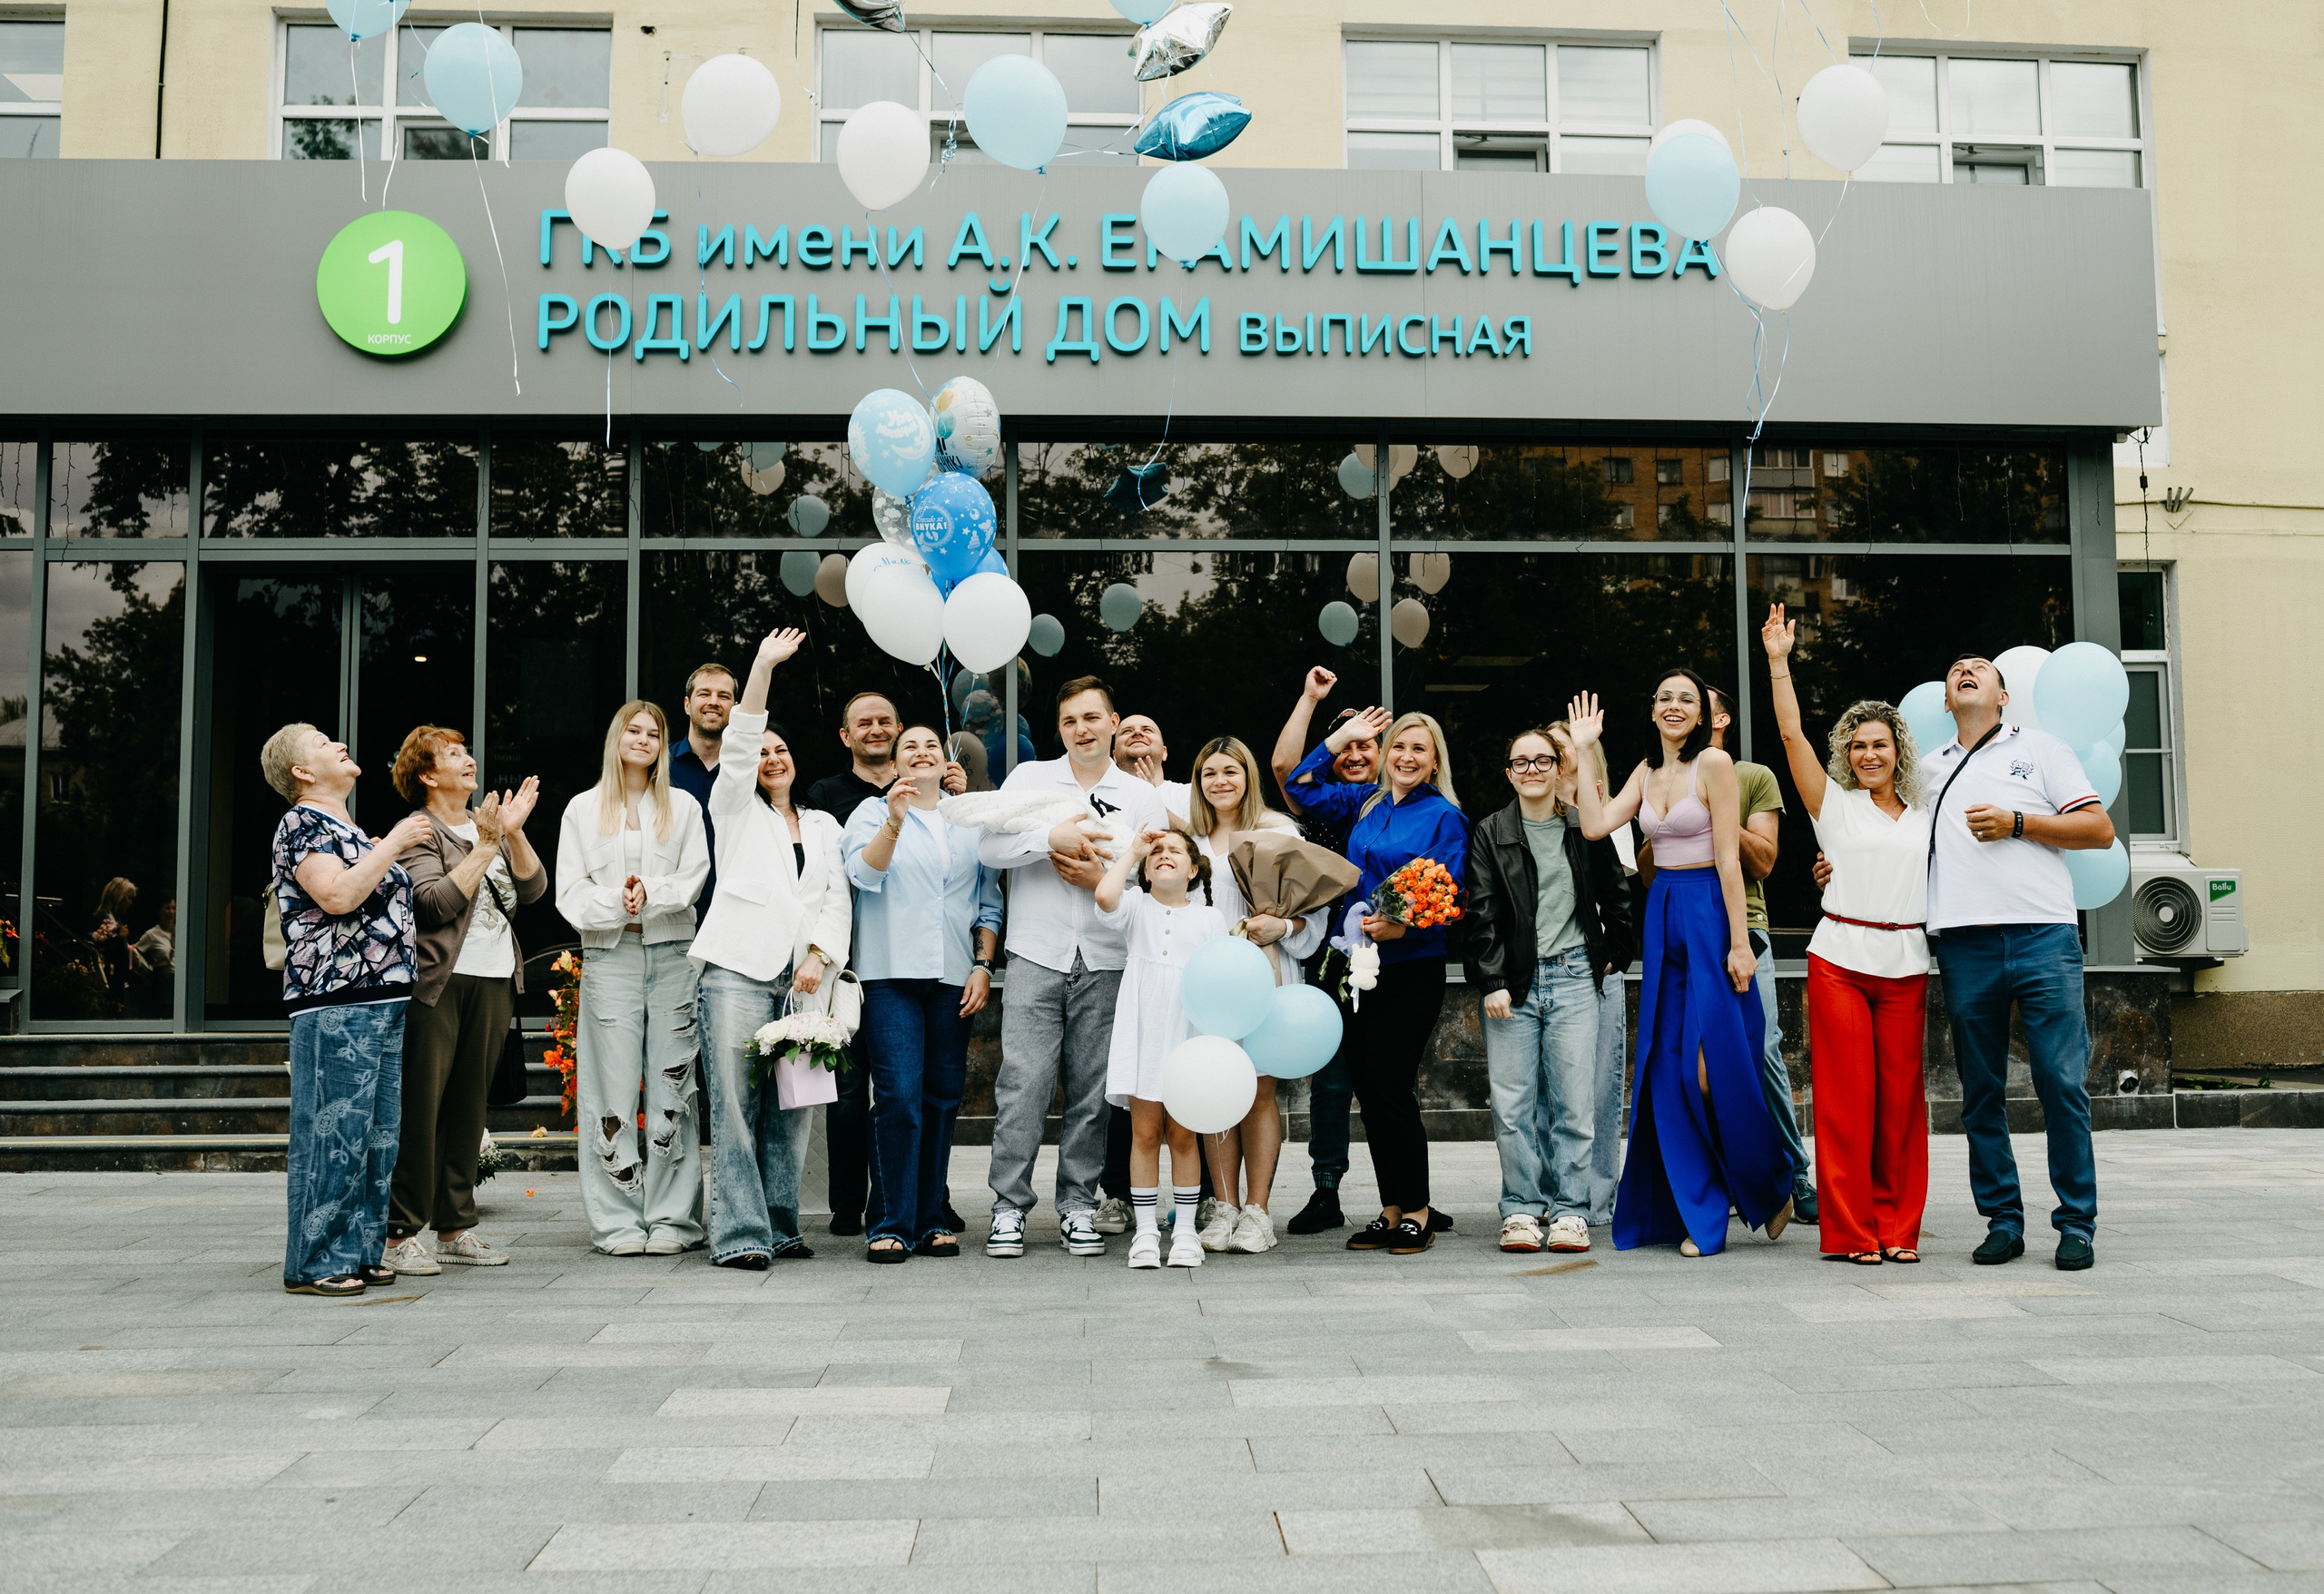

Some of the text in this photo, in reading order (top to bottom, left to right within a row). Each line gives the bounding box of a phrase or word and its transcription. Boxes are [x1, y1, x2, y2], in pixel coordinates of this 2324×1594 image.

[697, 224, 923, 266] имени
[1102, 213, 1719, 283] ЕМИШАНЦЕВА
[368, 239, 404, 325] 1
[368, 333, 412, 345] КОРПУС
[537, 279, 1021, 360] РОДИЛЬНЫЙ
[1046, 296, 1209, 361] ДОМ
[915, 522, 948, 531] ВНУКА!
[2211, 882, 2232, 890] Ballu
